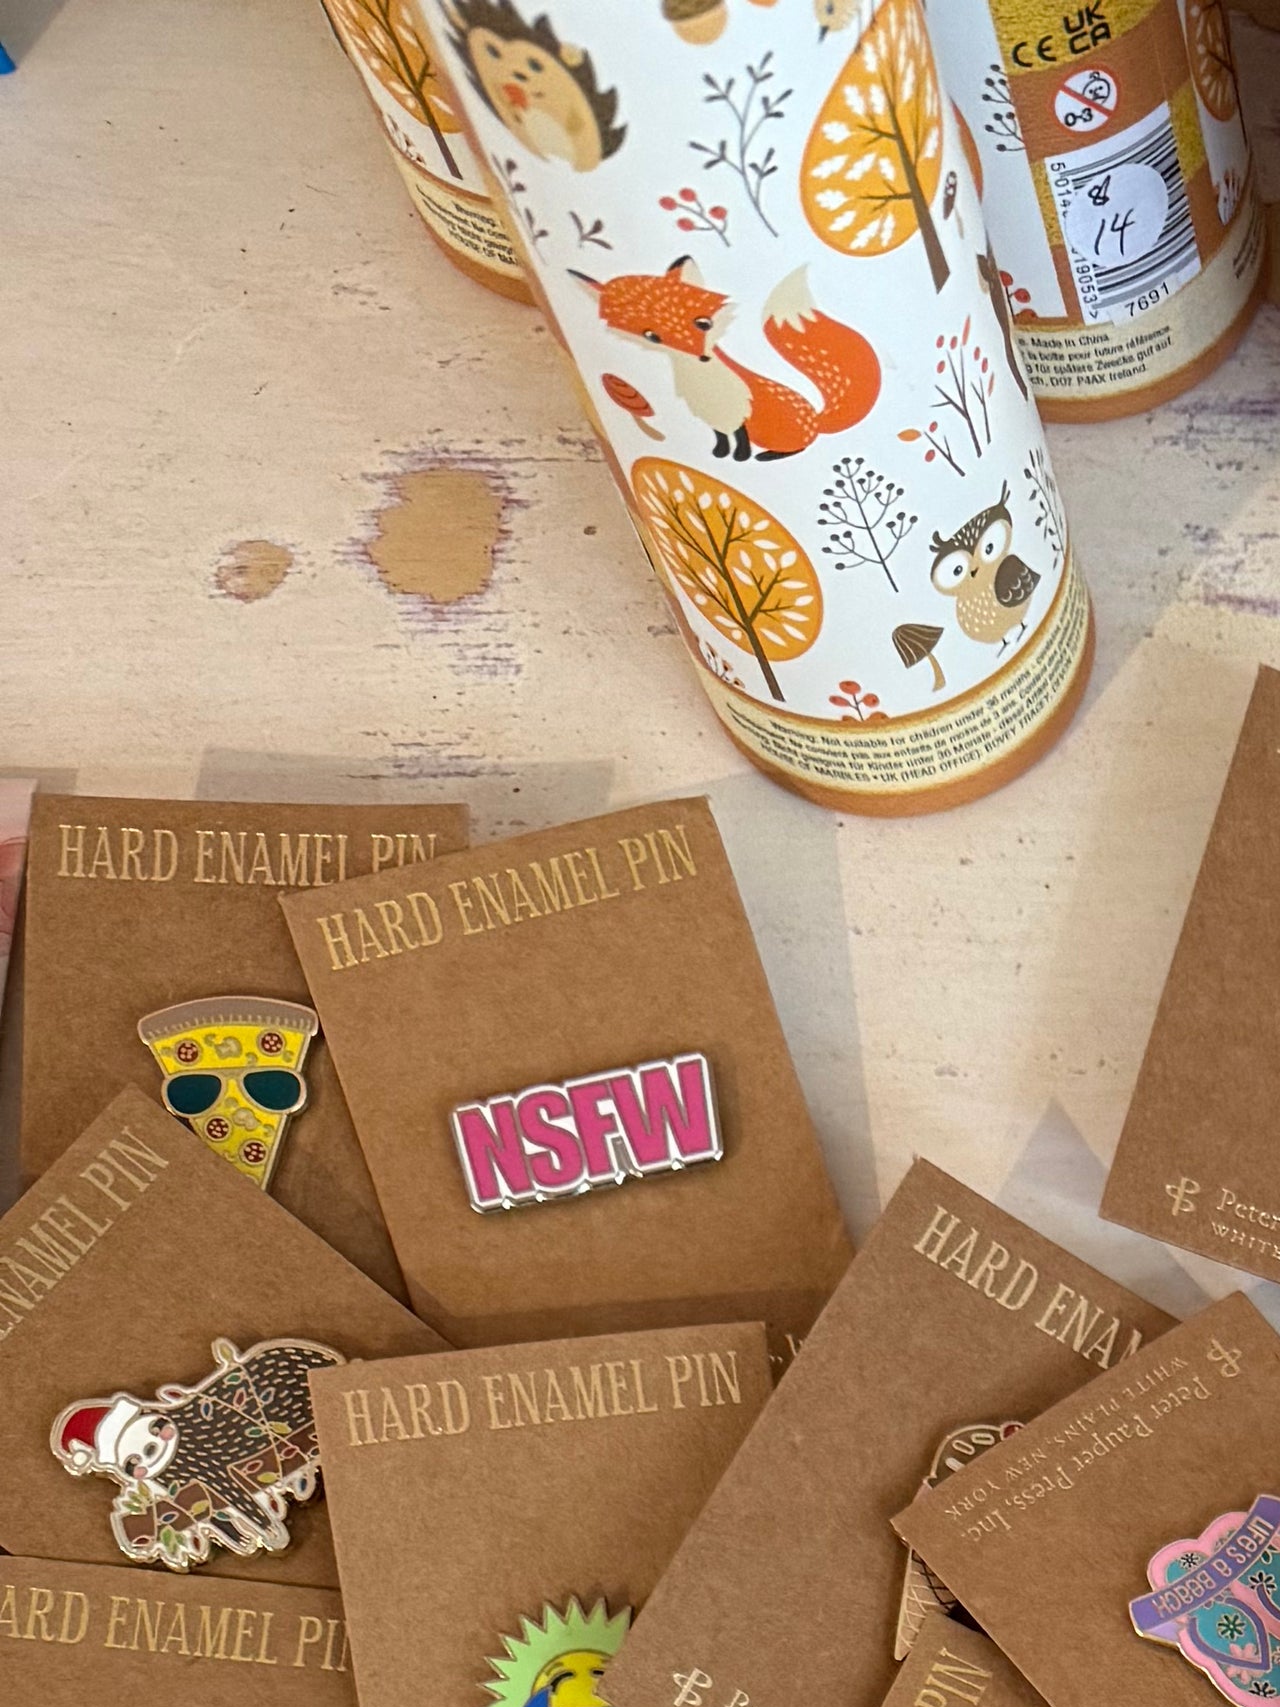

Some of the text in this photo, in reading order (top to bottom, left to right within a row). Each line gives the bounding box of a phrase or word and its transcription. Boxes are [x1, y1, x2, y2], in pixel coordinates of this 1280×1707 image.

[1063, 3, 1104, 34] UK
[1013, 36, 1057, 67] CE
[1068, 23, 1112, 55] CA
[1064, 108, 1093, 126] 0-3
[1094, 208, 1135, 256] 14
[1125, 282, 1171, 318] 7691
[1031, 337, 1063, 349] Made
[1078, 334, 1110, 346] China
[316, 823, 700, 972] HARD ENAMEL PIN
[456, 1058, 715, 1203] NSFW
